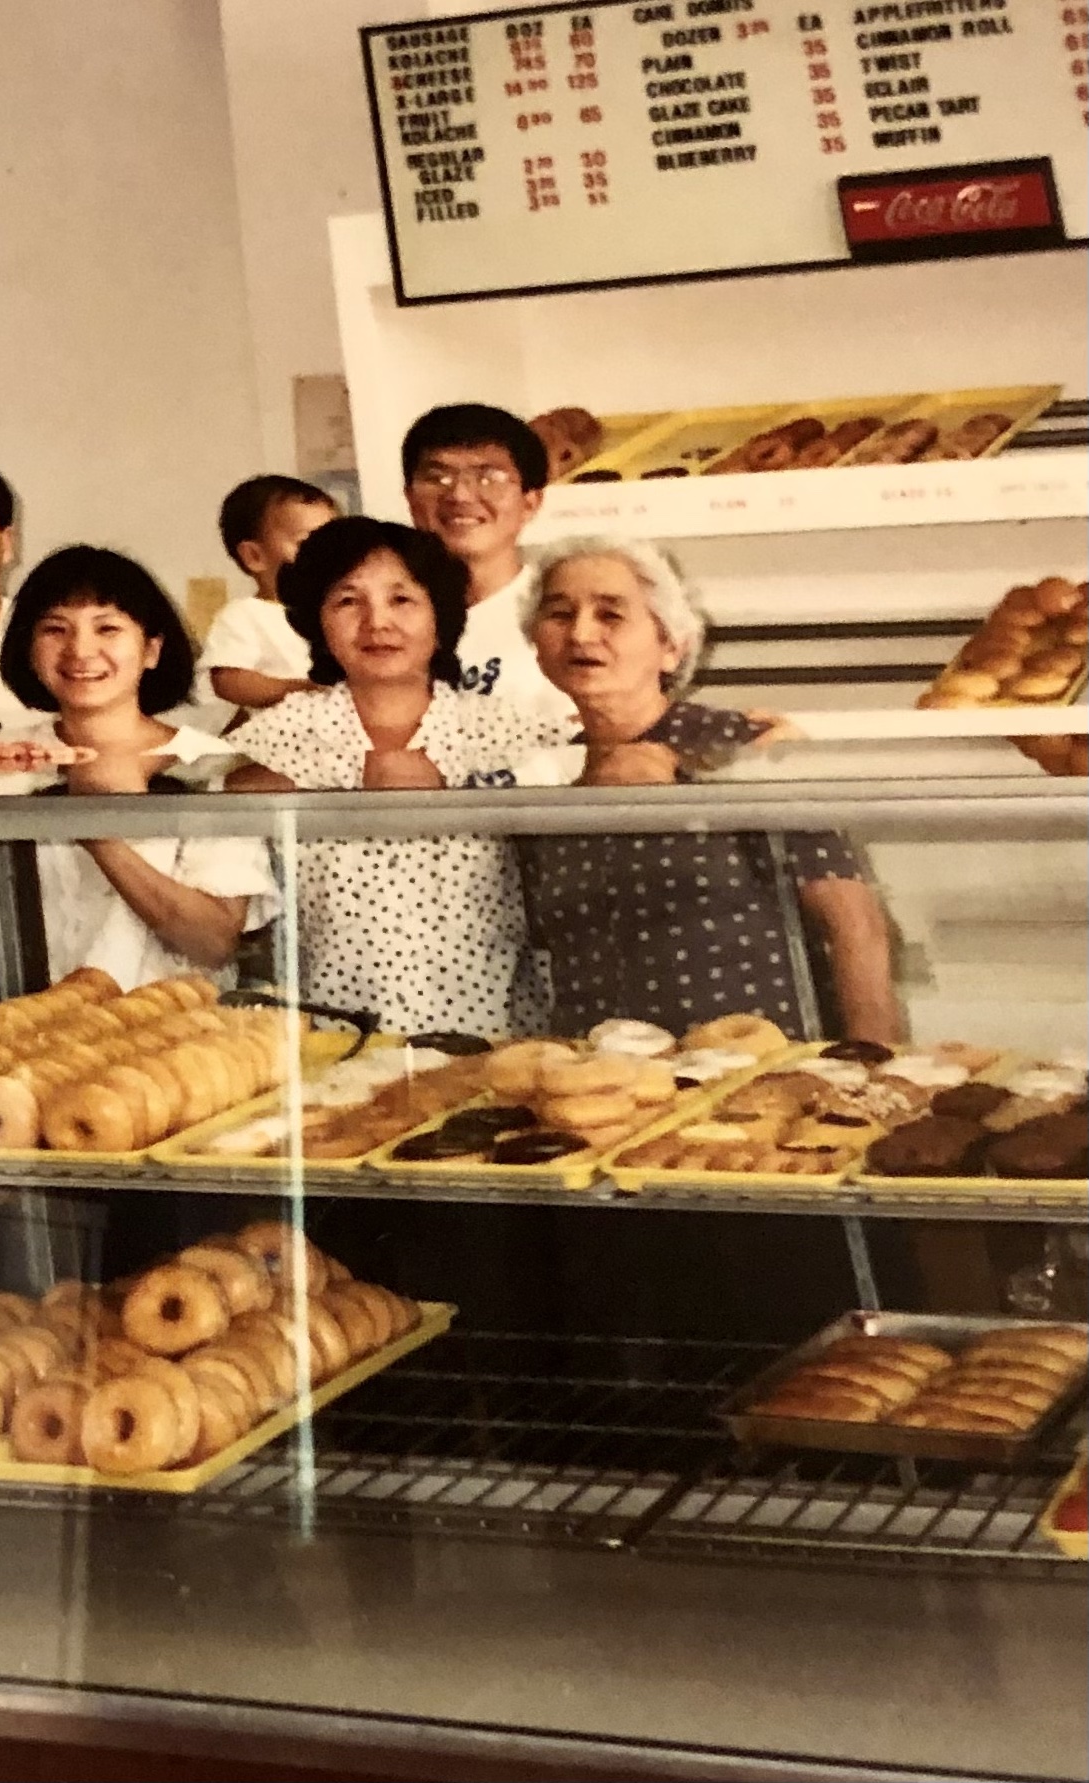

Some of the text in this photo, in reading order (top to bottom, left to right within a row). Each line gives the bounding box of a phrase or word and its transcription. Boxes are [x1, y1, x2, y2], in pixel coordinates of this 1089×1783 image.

[632, 4, 674, 24] CAKE
[797, 13, 822, 31] EA
[387, 26, 469, 52] SAUSAGE
[661, 26, 721, 48] DOZEN
[856, 15, 1013, 49] CINNAMON ROLL
[388, 45, 469, 71] KOLACHE
[802, 38, 828, 58] 35
[641, 54, 693, 75] PLAIN
[808, 61, 832, 80] 35
[860, 52, 921, 75] TWIST
[646, 71, 746, 99] CHOCOLATE
[811, 85, 836, 105] 35
[864, 75, 929, 99] ECLAIR
[649, 96, 751, 122] GLAZE CAKE
[816, 110, 842, 129] 35
[869, 102, 930, 123] PECAN
[397, 110, 450, 134] FRUIT
[401, 122, 478, 147] KOLACHE
[652, 121, 742, 148] CINNAMON
[820, 135, 846, 154] 35
[872, 125, 941, 149] MUFFIN
[406, 147, 484, 169] REGULAR
[656, 144, 757, 172] BLUEBERRY
[418, 166, 475, 185] GLAZE
[414, 188, 454, 206] ICED
[416, 201, 480, 223] FILLED
